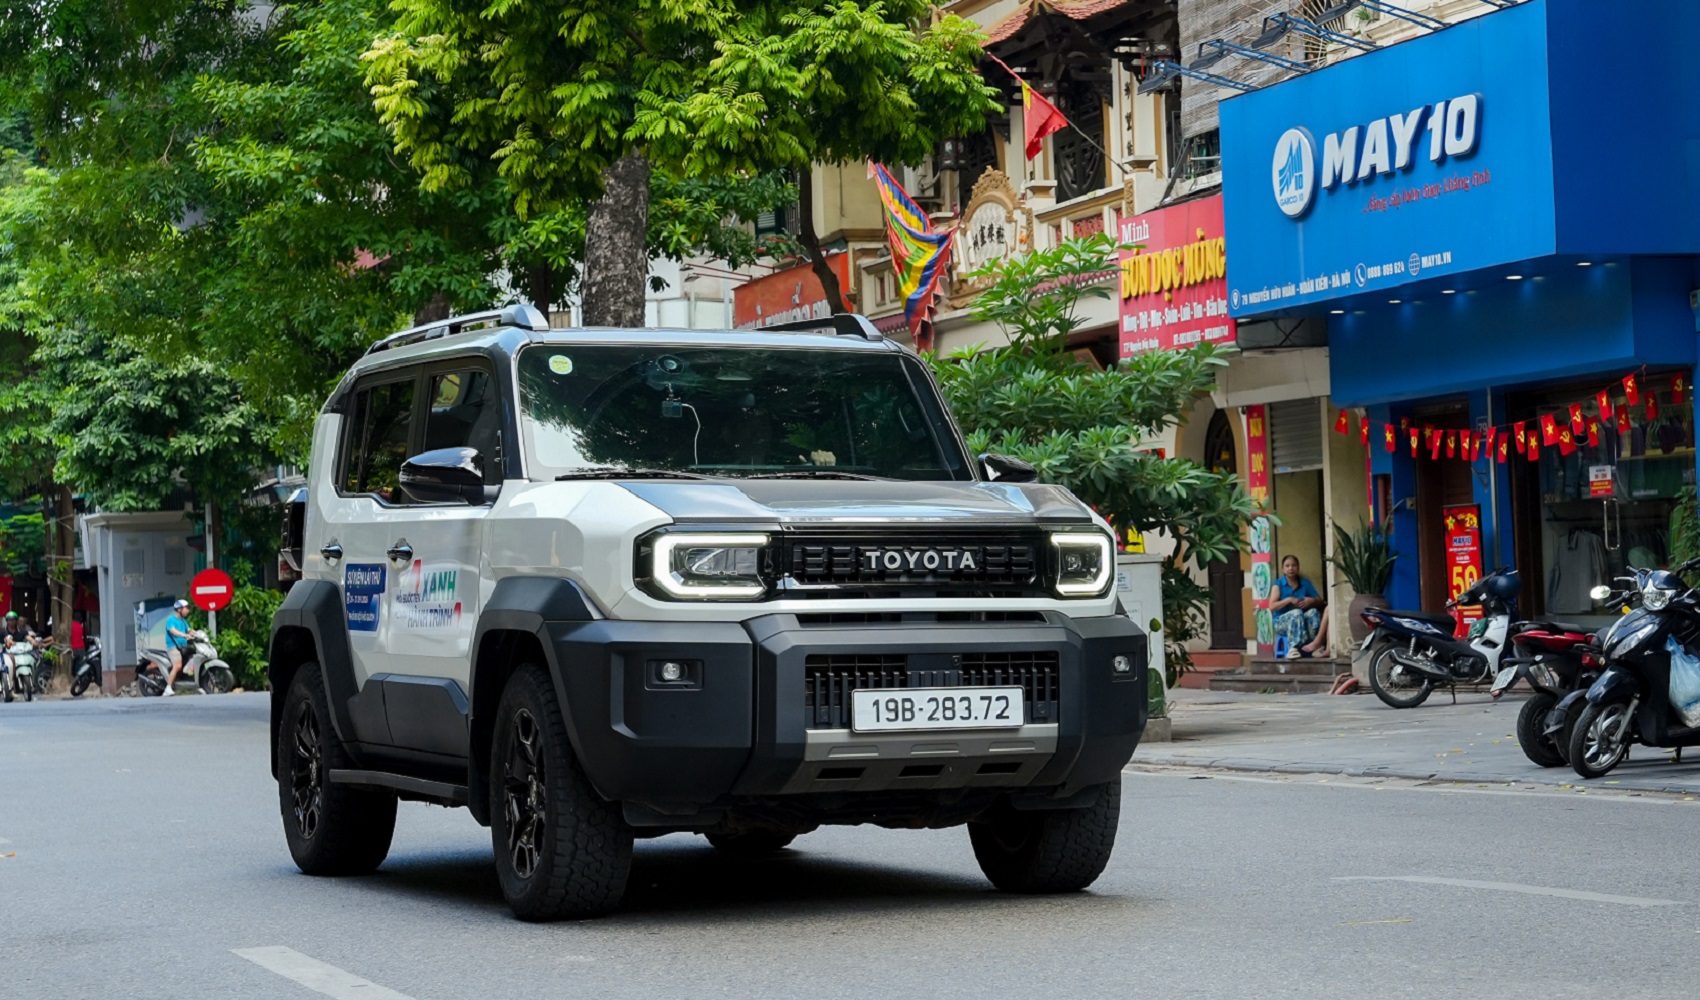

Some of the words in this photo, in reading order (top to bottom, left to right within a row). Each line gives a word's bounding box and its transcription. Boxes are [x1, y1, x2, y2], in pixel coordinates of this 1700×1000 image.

[1322, 106, 1424, 189] MAY
[1427, 93, 1479, 162] 10
[1121, 219, 1150, 244] Minh
[1121, 248, 1150, 299] BÚN
[1422, 251, 1452, 269] MAY10.VN
[866, 551, 976, 569] TOYOTA
[422, 570, 457, 602] XANH
[872, 695, 1010, 723] 19B-283.72
